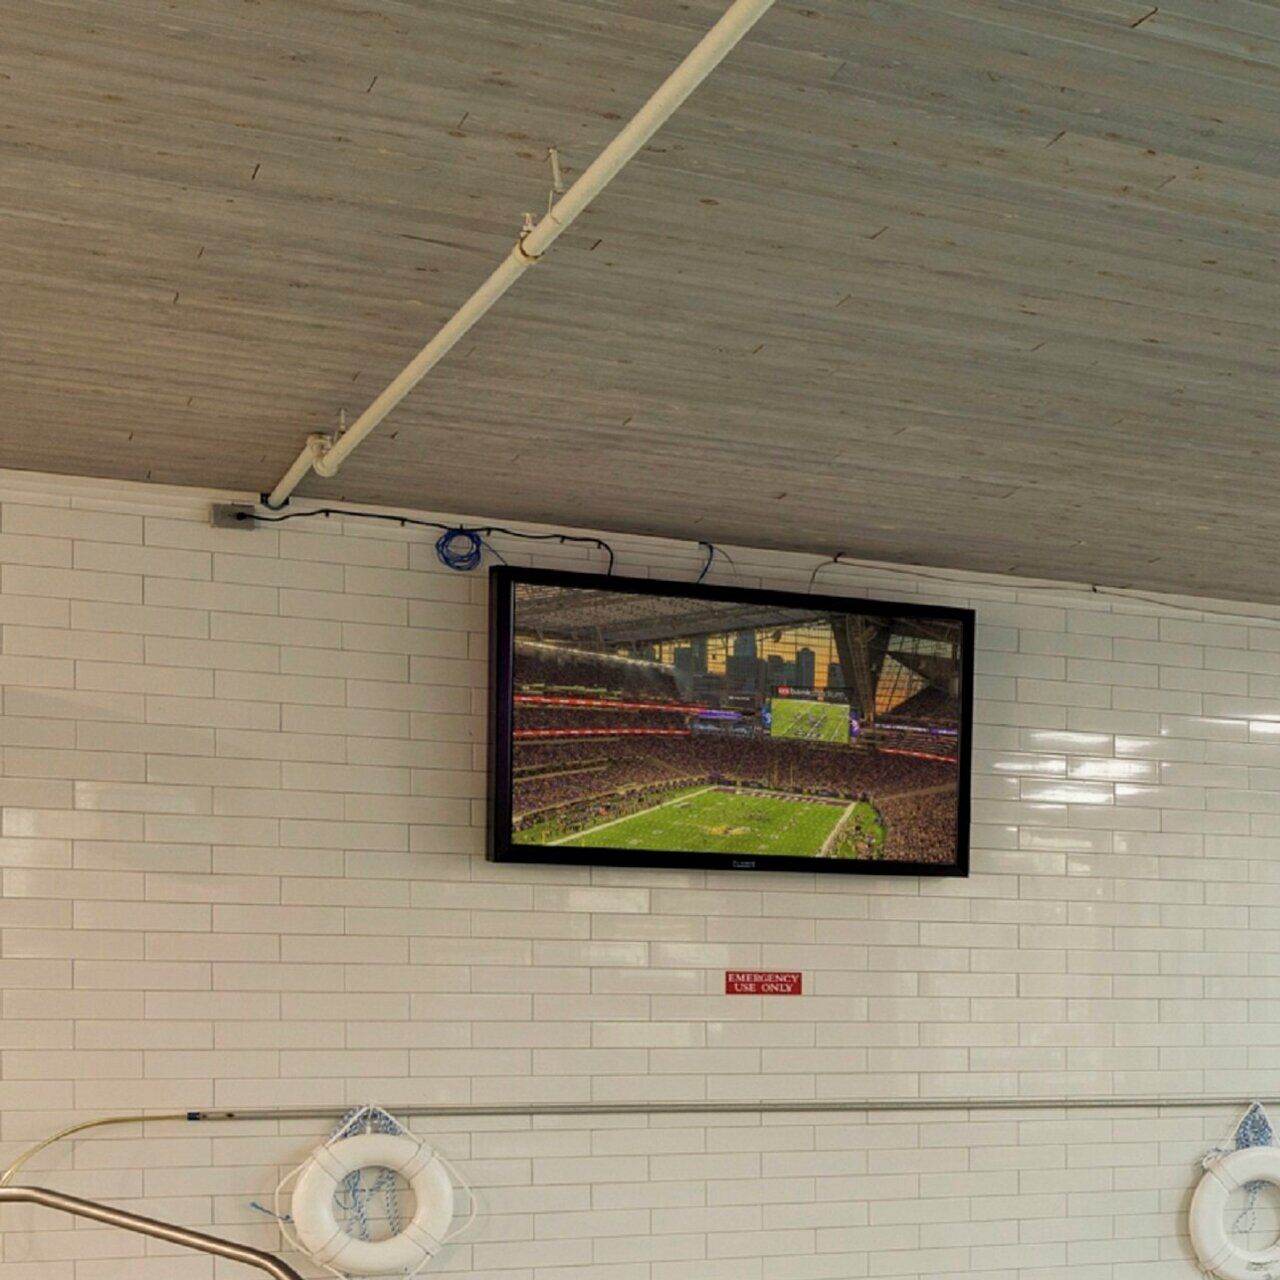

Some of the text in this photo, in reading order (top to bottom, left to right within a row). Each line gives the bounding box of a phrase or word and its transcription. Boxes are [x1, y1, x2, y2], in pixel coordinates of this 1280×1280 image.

[728, 973, 799, 983] EMERGENCY
[734, 983, 793, 993] USE ONLY
